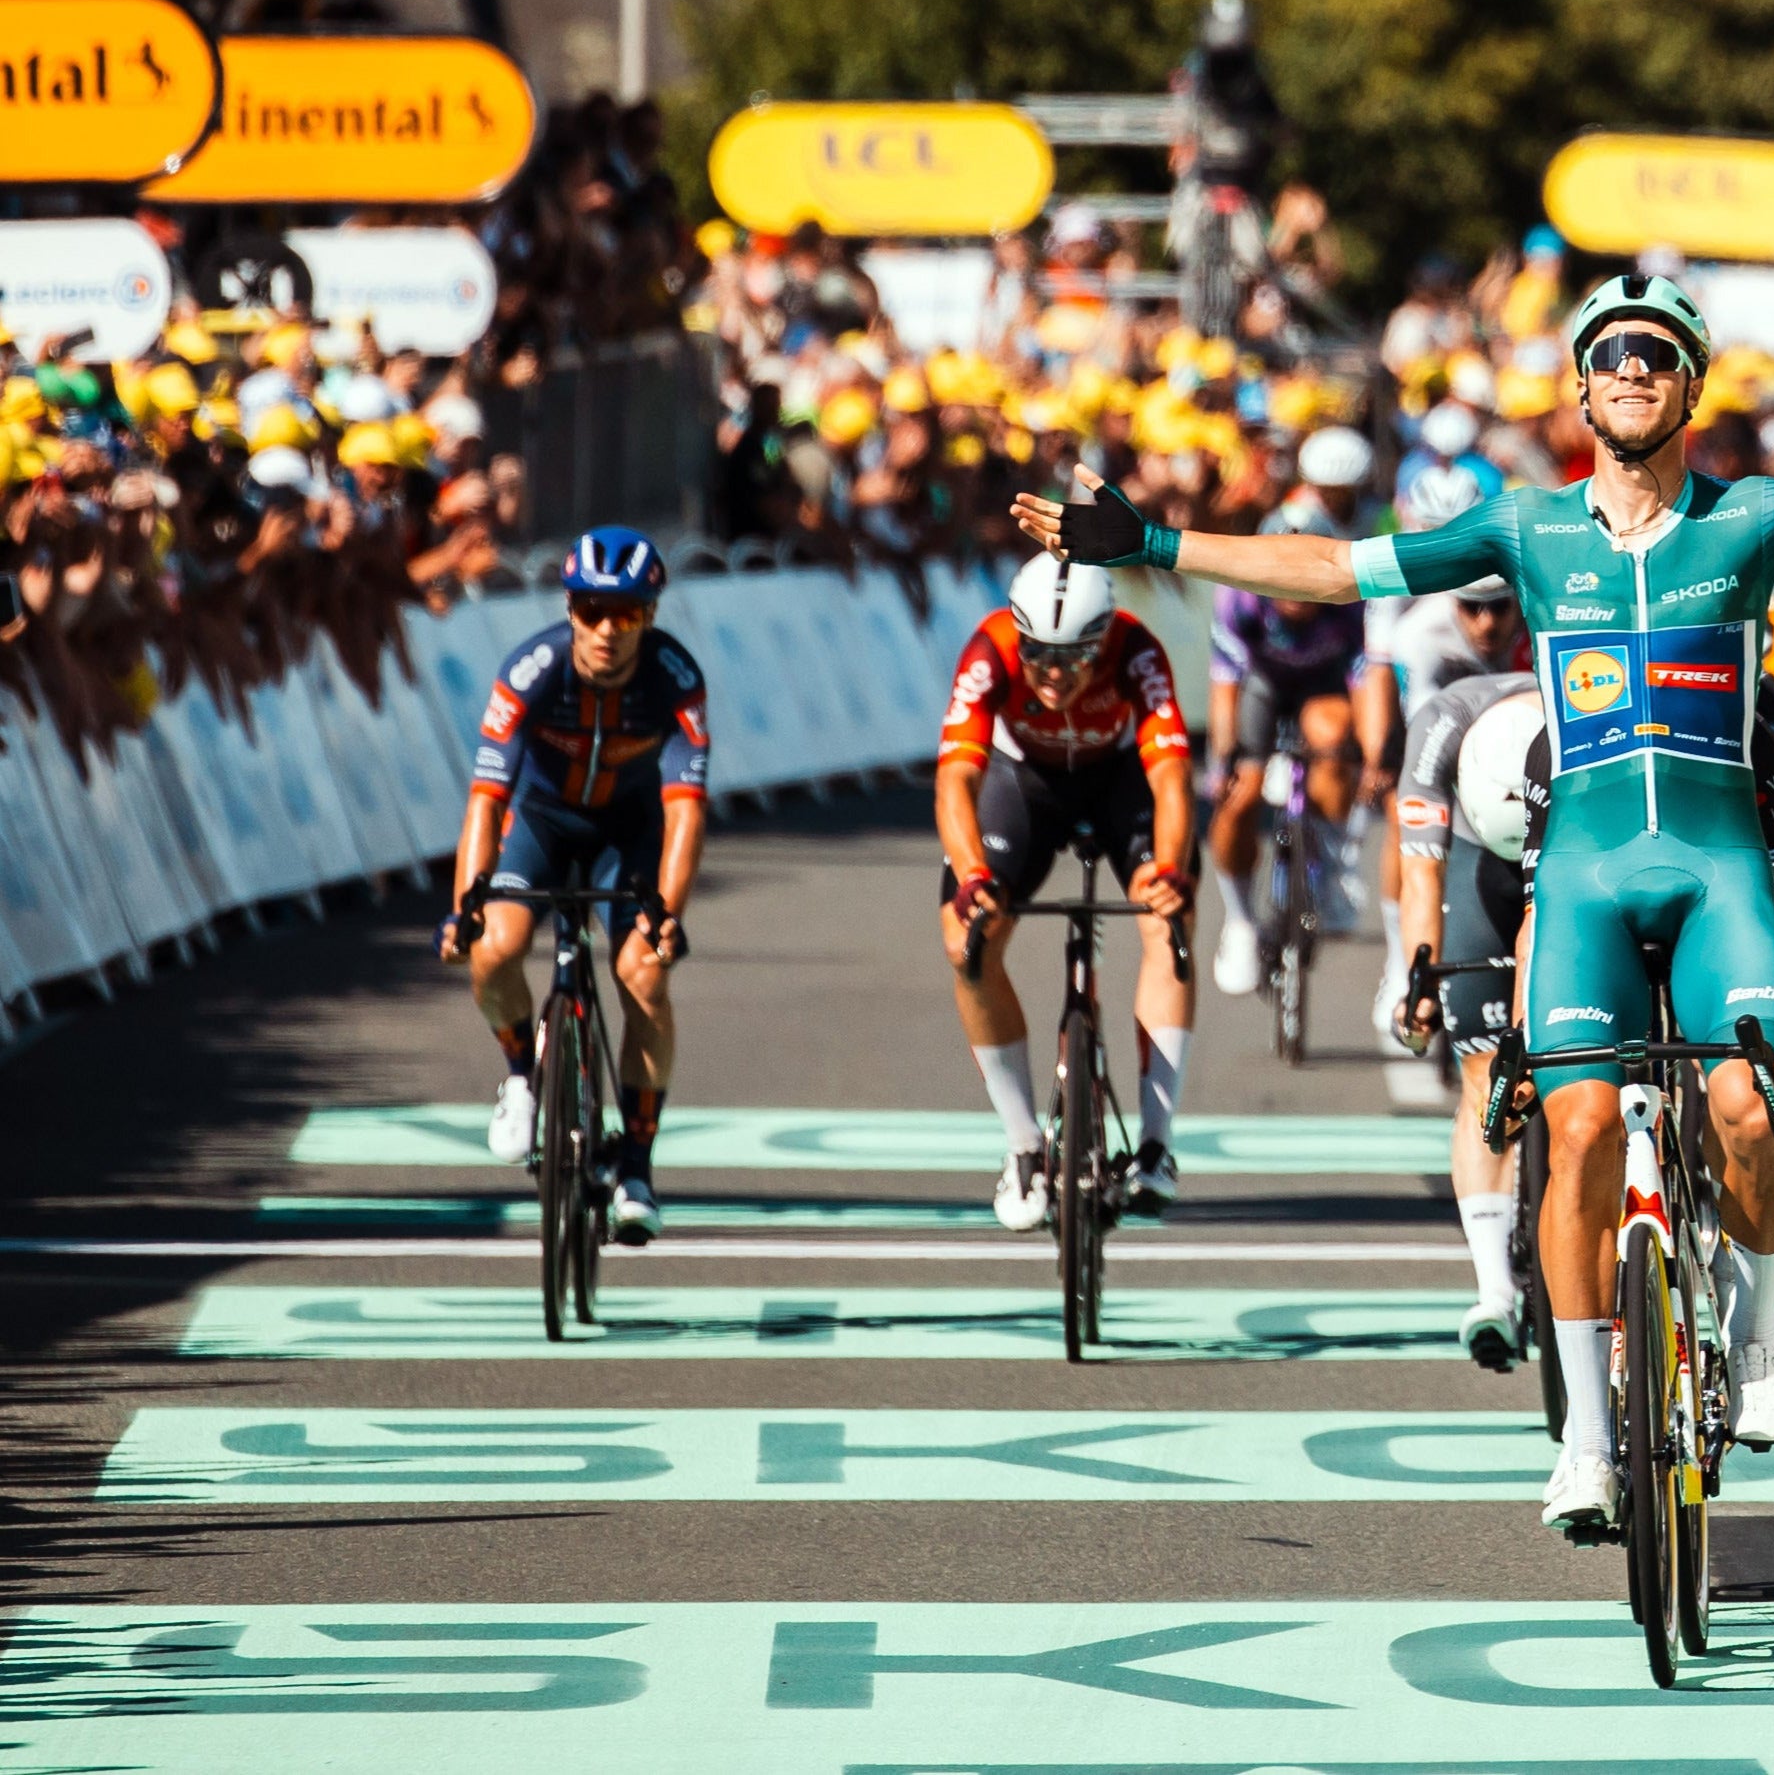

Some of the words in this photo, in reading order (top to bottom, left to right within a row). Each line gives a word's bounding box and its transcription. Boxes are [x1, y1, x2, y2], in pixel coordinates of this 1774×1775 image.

[1555, 604, 1616, 622] Santini
[1652, 668, 1731, 683] TREK
[1546, 1005, 1614, 1026] Santini
